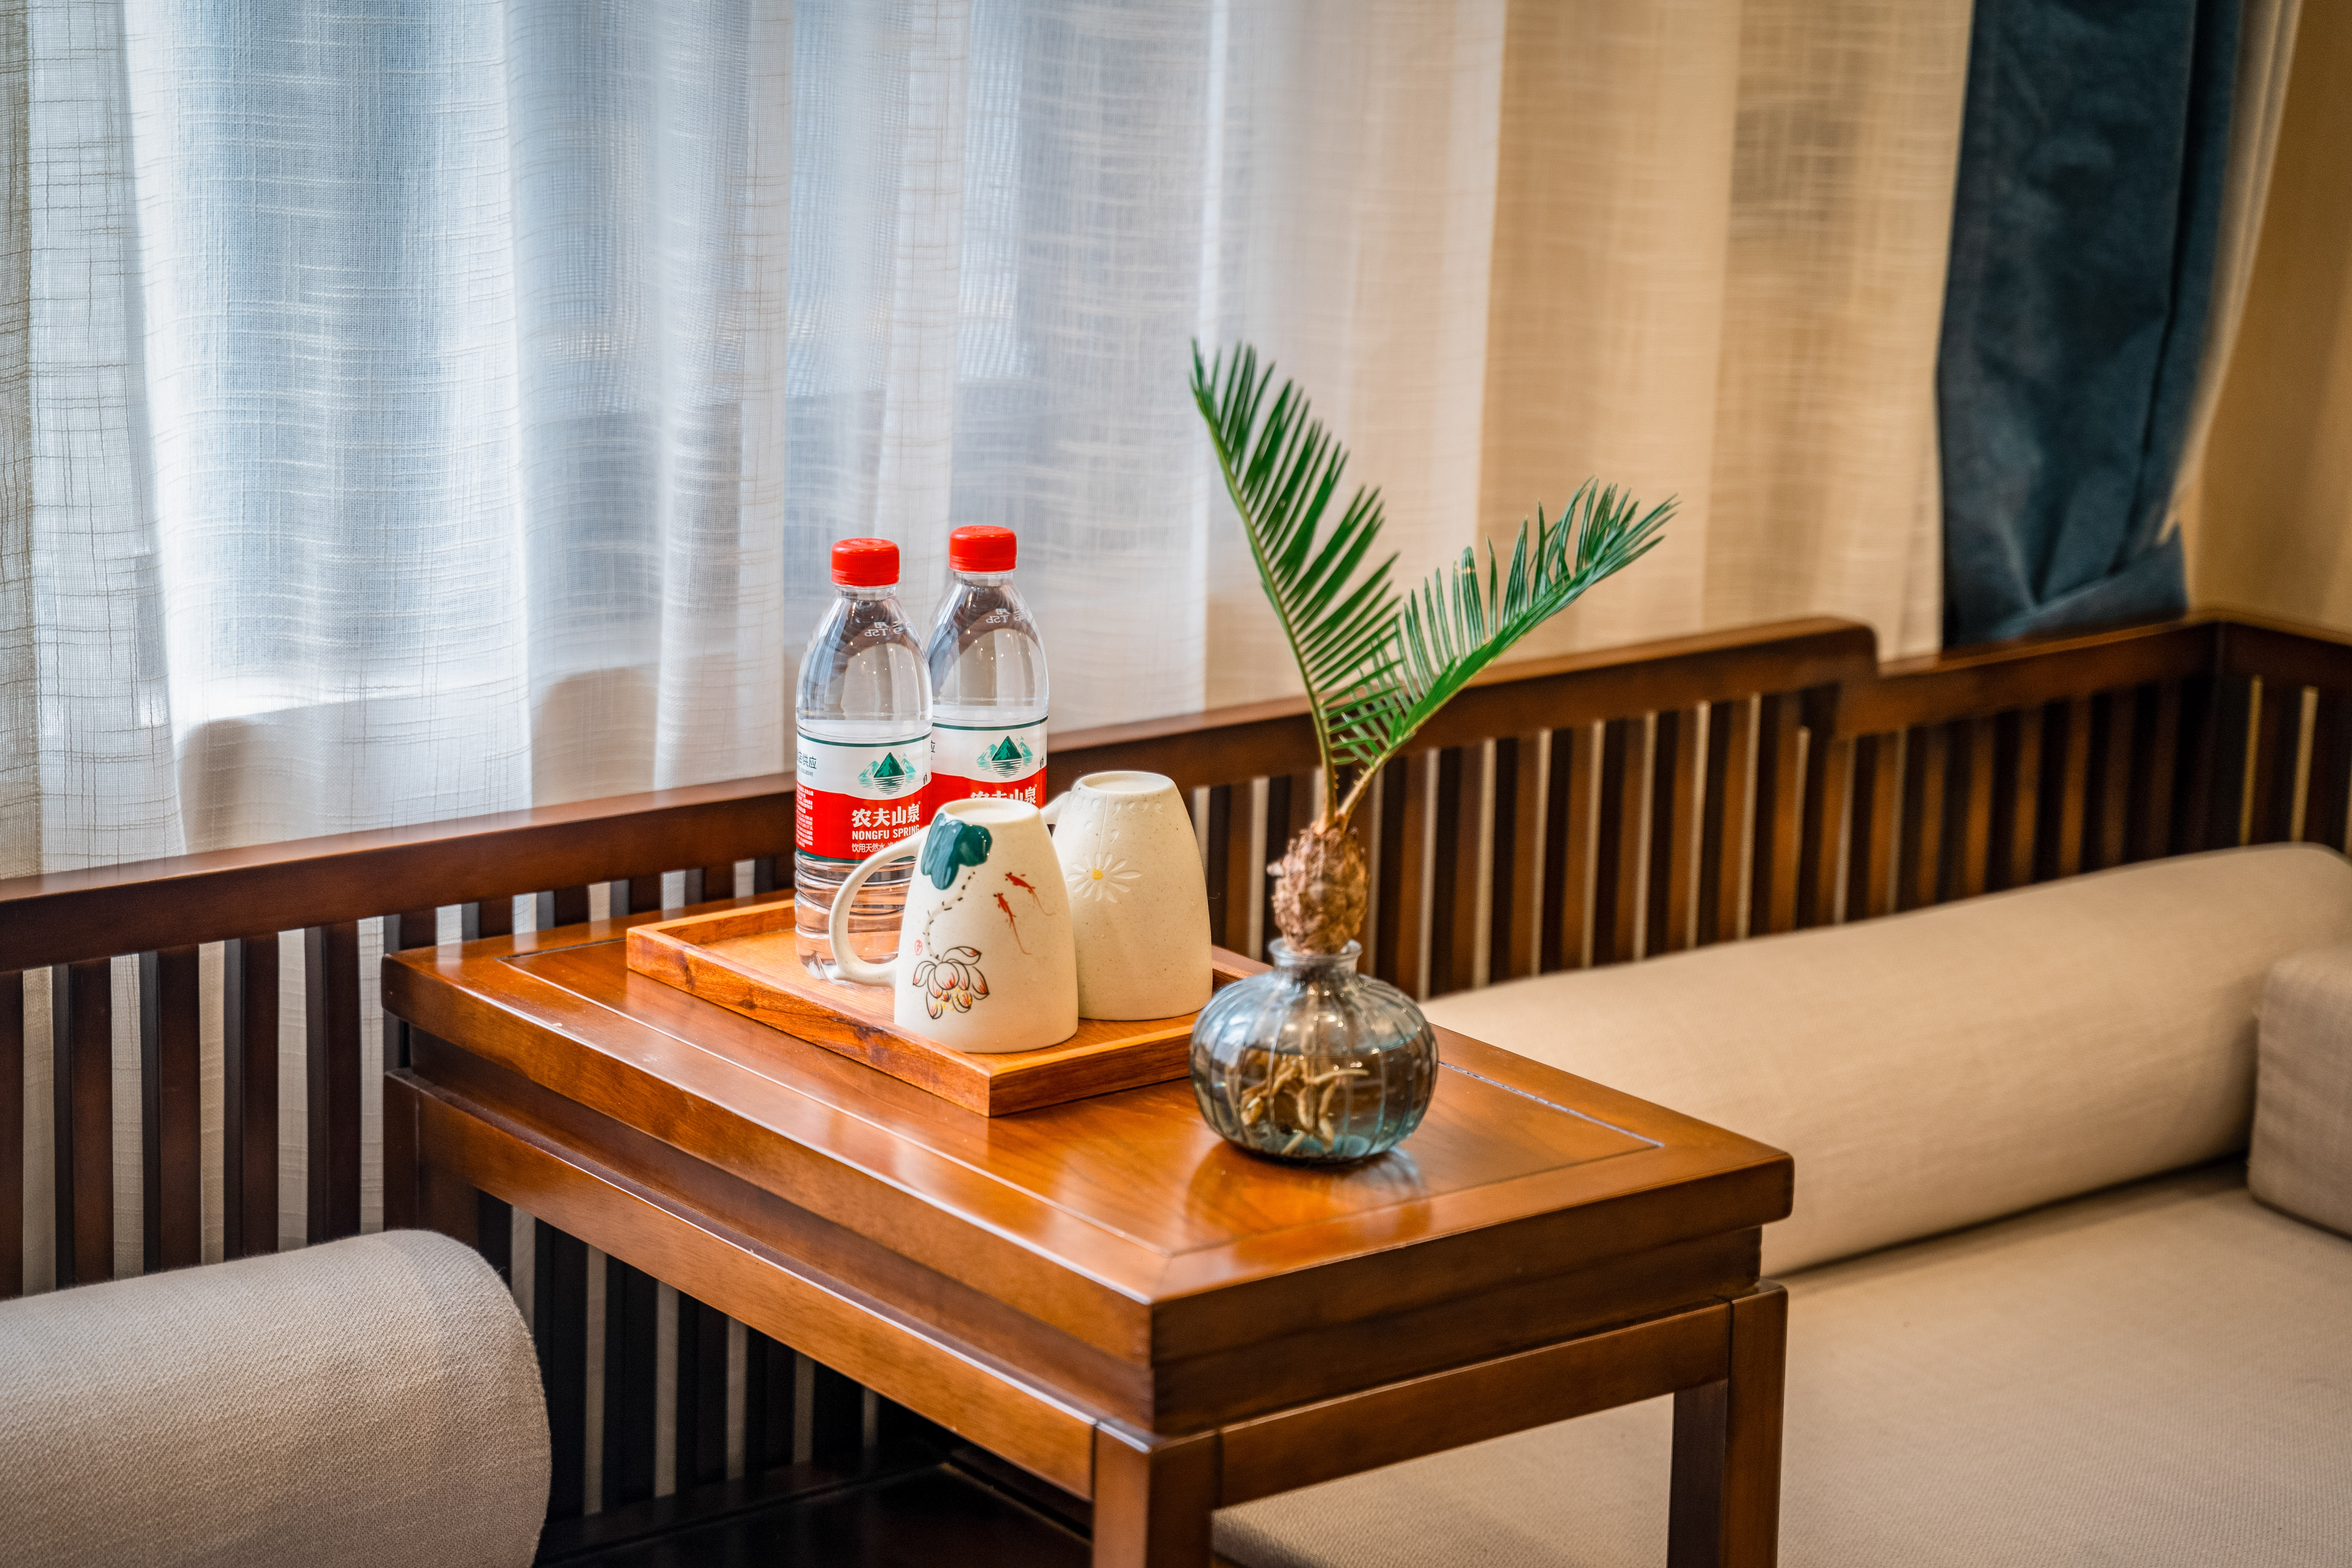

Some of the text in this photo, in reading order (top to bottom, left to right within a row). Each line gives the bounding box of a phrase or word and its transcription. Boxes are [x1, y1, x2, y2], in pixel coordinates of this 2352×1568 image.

[851, 804, 920, 828] 农夫山泉
[852, 824, 920, 840] NONGFU SPRING
